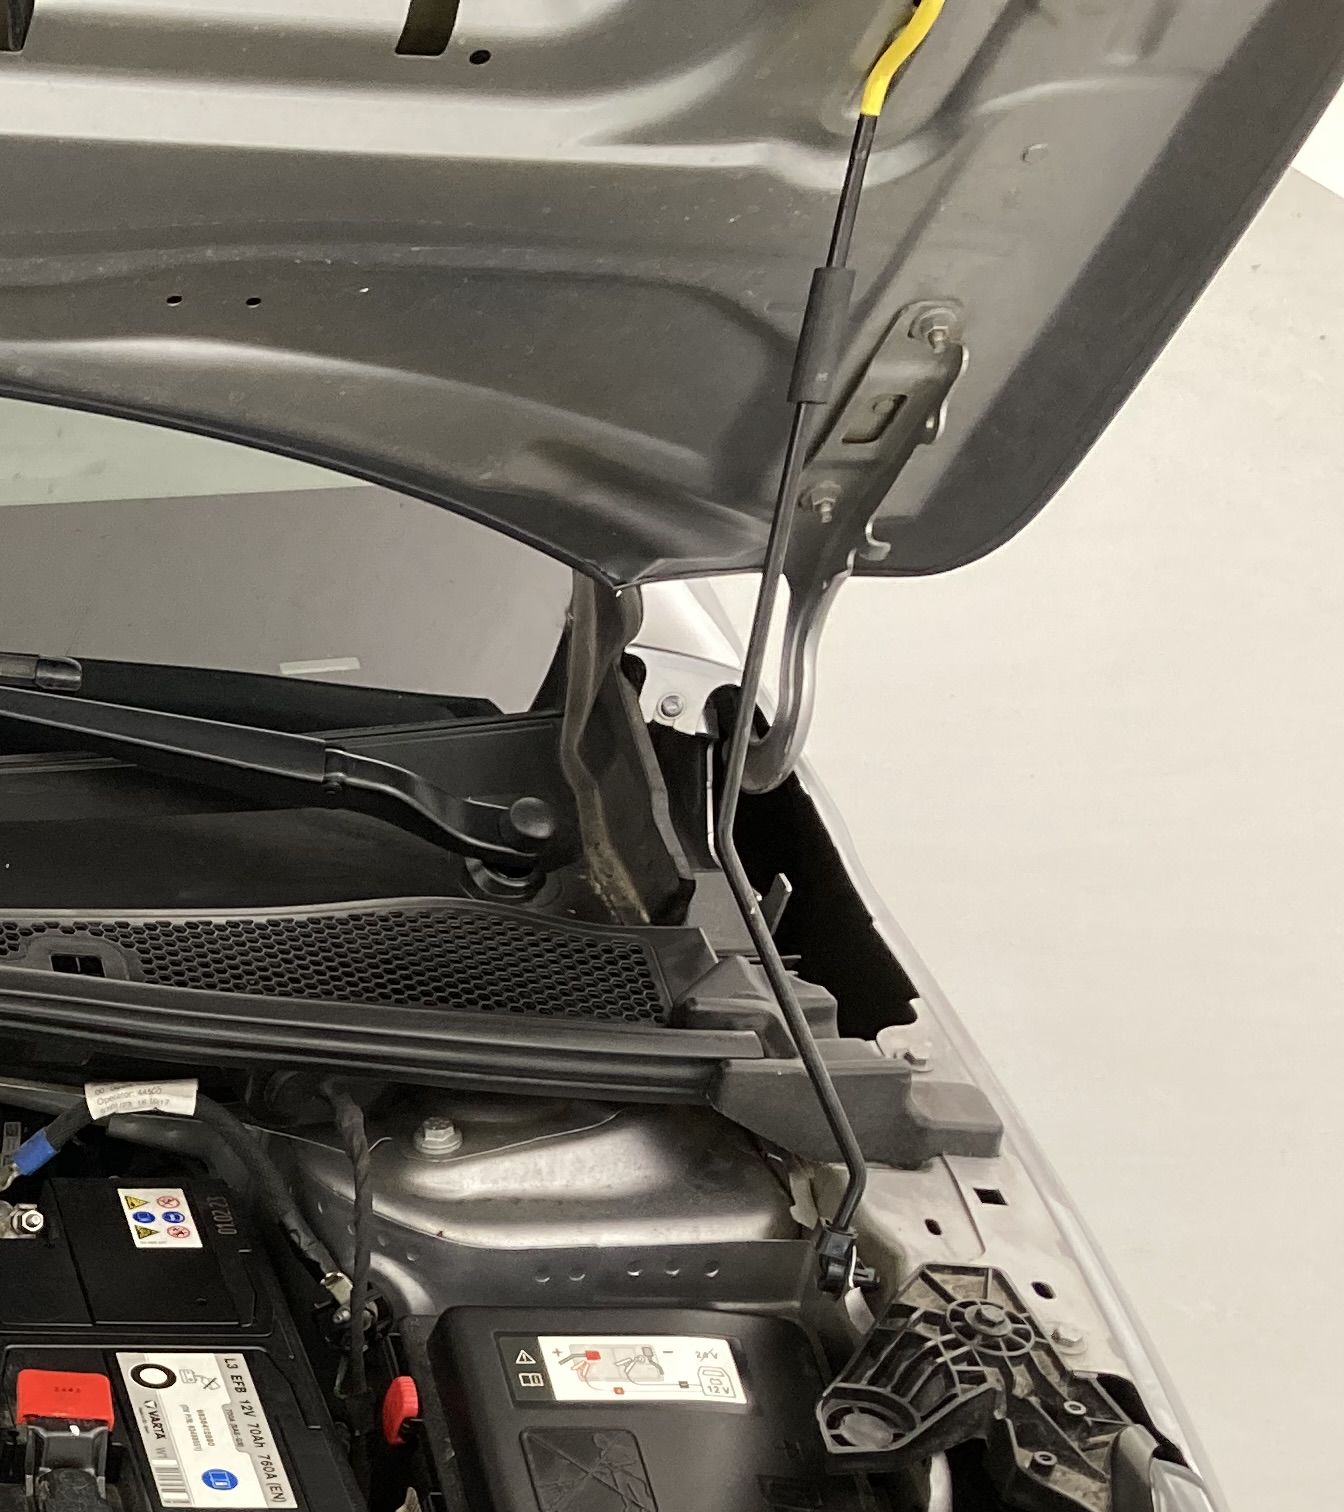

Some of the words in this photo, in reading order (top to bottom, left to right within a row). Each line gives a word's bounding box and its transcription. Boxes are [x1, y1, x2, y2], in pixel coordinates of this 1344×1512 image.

[224, 1358, 238, 1370] L3
[230, 1374, 247, 1394] EFB
[239, 1399, 257, 1418] 12V
[148, 1408, 166, 1440] VARTA
[247, 1423, 266, 1448] 70Ah
[258, 1454, 277, 1480] 760A
[266, 1482, 287, 1503] (EN)
